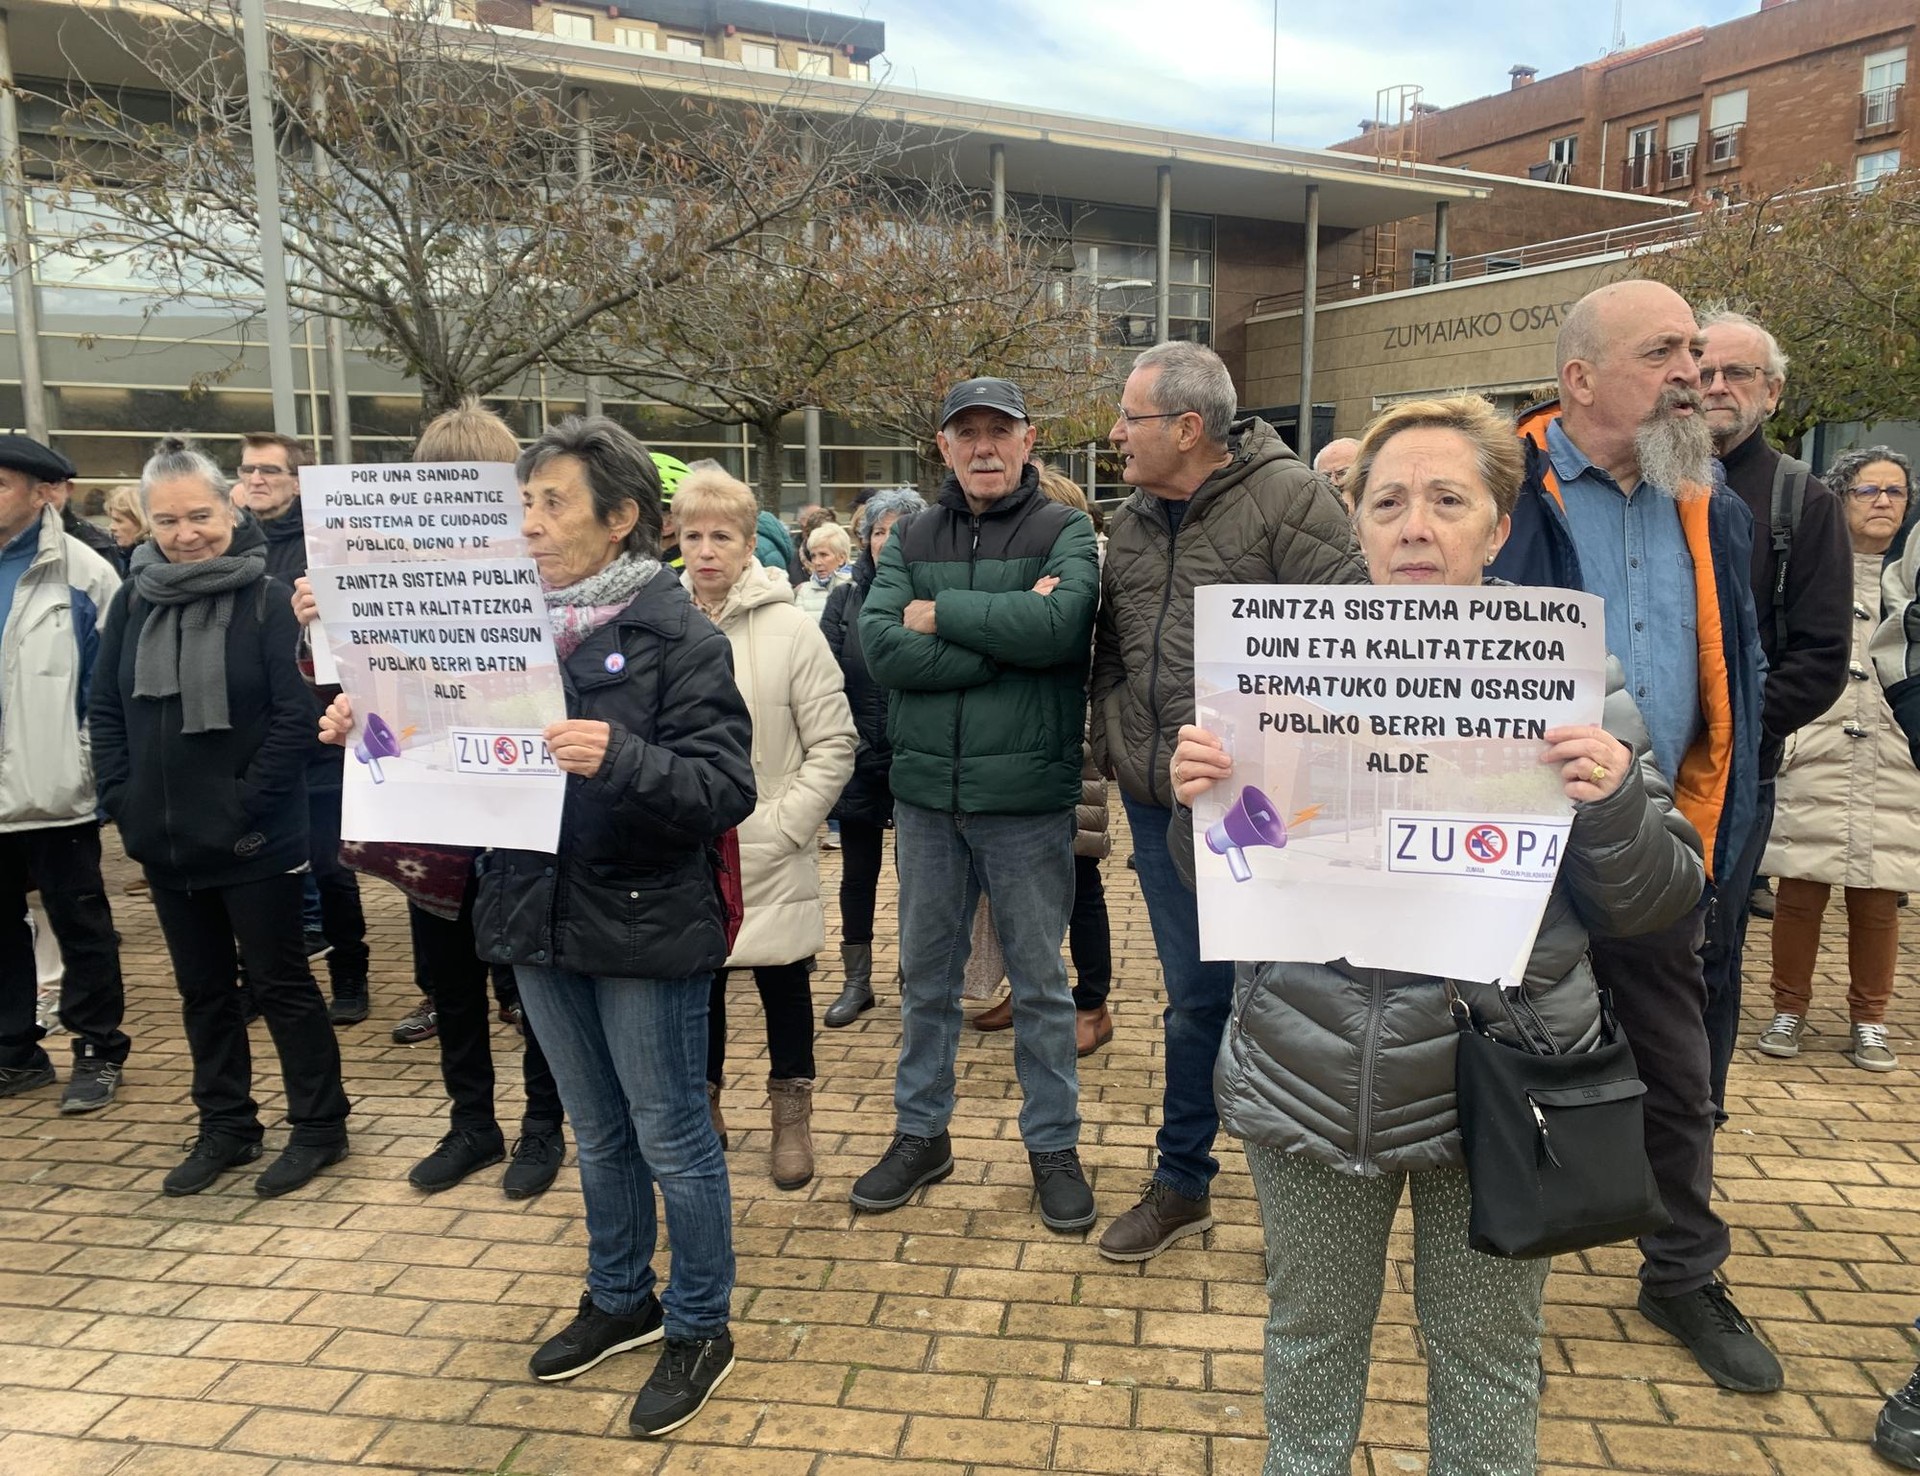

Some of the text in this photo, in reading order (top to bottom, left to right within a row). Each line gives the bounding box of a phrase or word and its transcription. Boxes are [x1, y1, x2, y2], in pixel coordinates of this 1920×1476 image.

[1383, 312, 1501, 350] ZUMAIAKO
[351, 468, 479, 483] POR UNA SANIDAD
[325, 490, 504, 507] PÚBLICA QUE GARANTICE
[325, 512, 508, 530] UN SISTEMA DE CUIDADOS
[346, 535, 490, 552] PÚBLICO, DIGNO Y DE
[335, 573, 399, 591] ZAINTZA
[402, 570, 467, 588] SISTEMA
[352, 597, 533, 618] DUIN ETA KALITATEZKOA
[1231, 598, 1587, 629] ZAINTZA SISTEMA PUBLIKO,
[350, 626, 542, 645] BERMATUKO DUEN OSASUN
[1246, 636, 1565, 662] DUIN ETA KALITATEZKOA
[368, 656, 527, 672] PUBLIKO BERRI BATEN
[433, 683, 467, 700] ALDE
[1237, 673, 1575, 702] BERMATUKO DUEN OSASUN
[1259, 712, 1546, 741] PUBLIKO BERRI BATEN
[1366, 752, 1430, 774] ALDE
